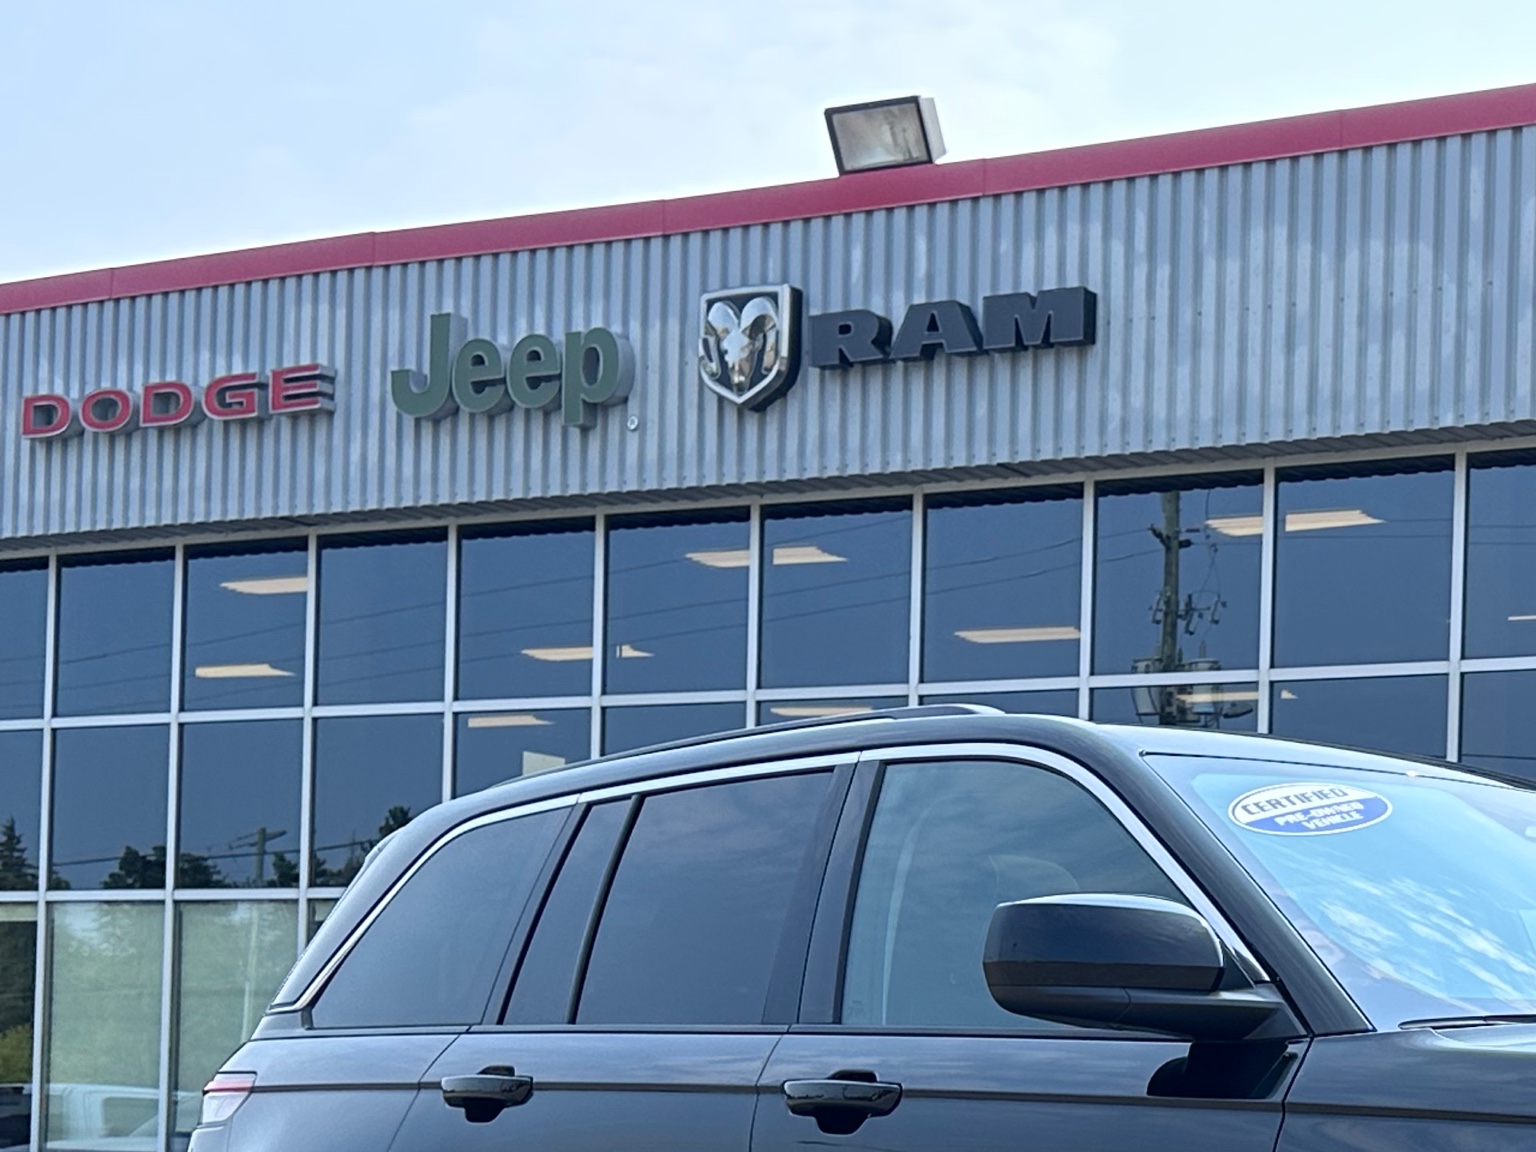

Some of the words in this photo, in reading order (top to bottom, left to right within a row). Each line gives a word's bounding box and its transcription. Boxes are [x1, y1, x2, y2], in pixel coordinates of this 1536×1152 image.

[806, 286, 1097, 371] RAM
[20, 363, 337, 442] DODGE
[391, 312, 628, 429] Jeep
[1242, 788, 1348, 815] CERTIFIED
